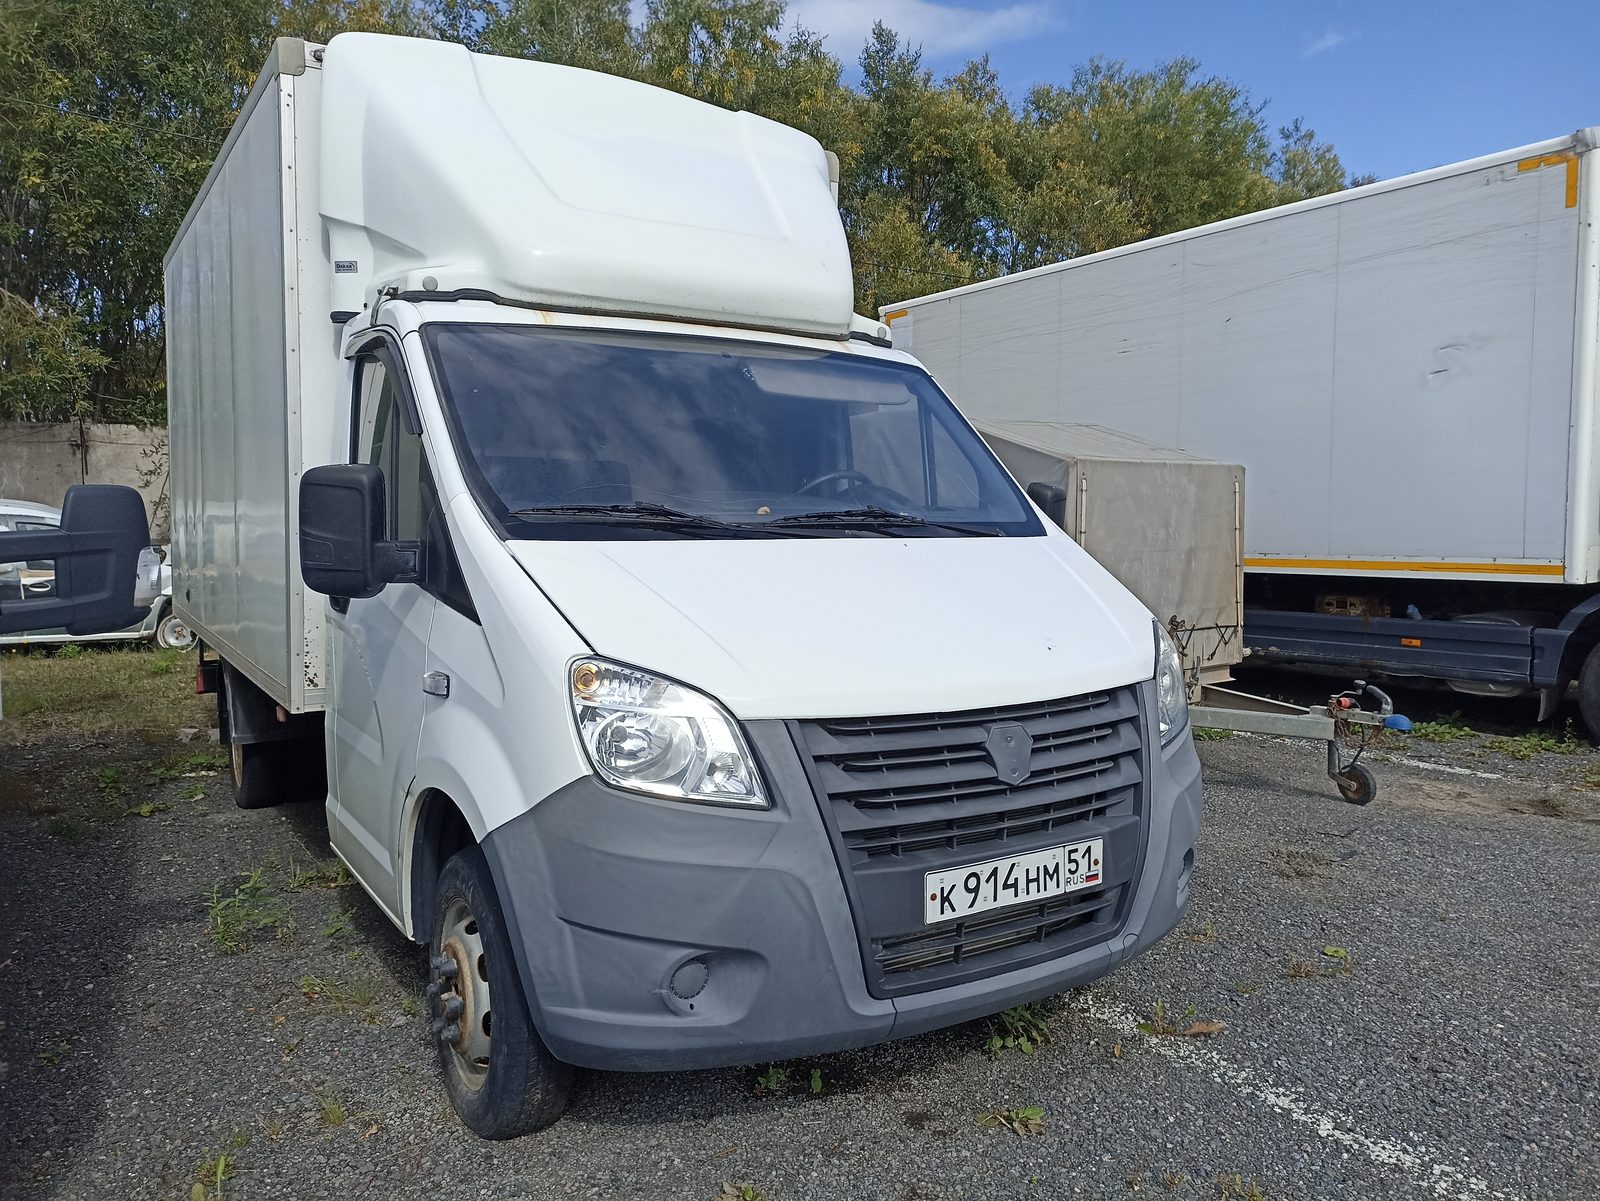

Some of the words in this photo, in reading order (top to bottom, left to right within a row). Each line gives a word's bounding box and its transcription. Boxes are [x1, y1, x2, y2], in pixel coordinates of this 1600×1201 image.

[940, 861, 1060, 915] К914НМ
[1067, 845, 1092, 875] 51
[1066, 876, 1085, 887] RUS
